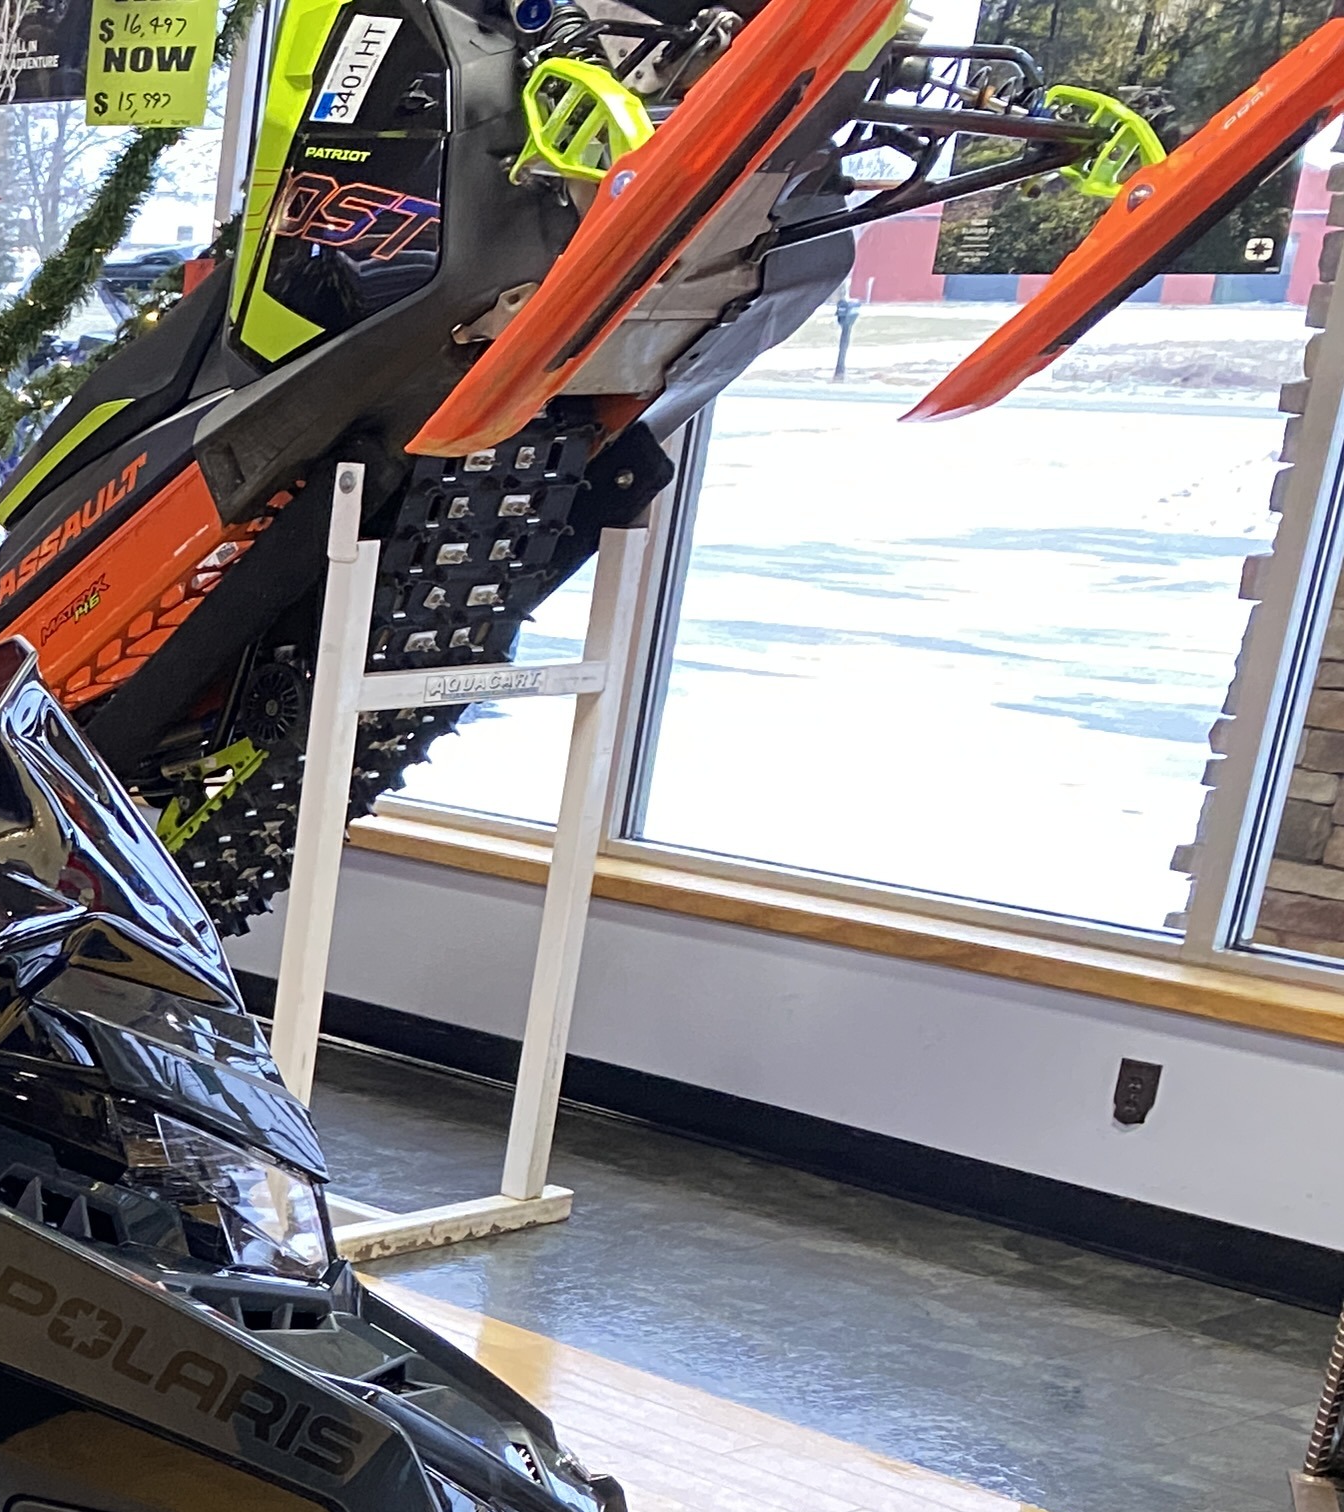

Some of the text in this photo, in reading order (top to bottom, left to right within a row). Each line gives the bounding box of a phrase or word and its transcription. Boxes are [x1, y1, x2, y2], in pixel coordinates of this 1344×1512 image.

[99, 14, 187, 43] $ 16,497
[103, 46, 197, 72] NOW
[94, 92, 108, 116] $
[305, 147, 371, 162] PATRIOT
[74, 594, 101, 624] 146
[430, 671, 542, 697] AQUACART
